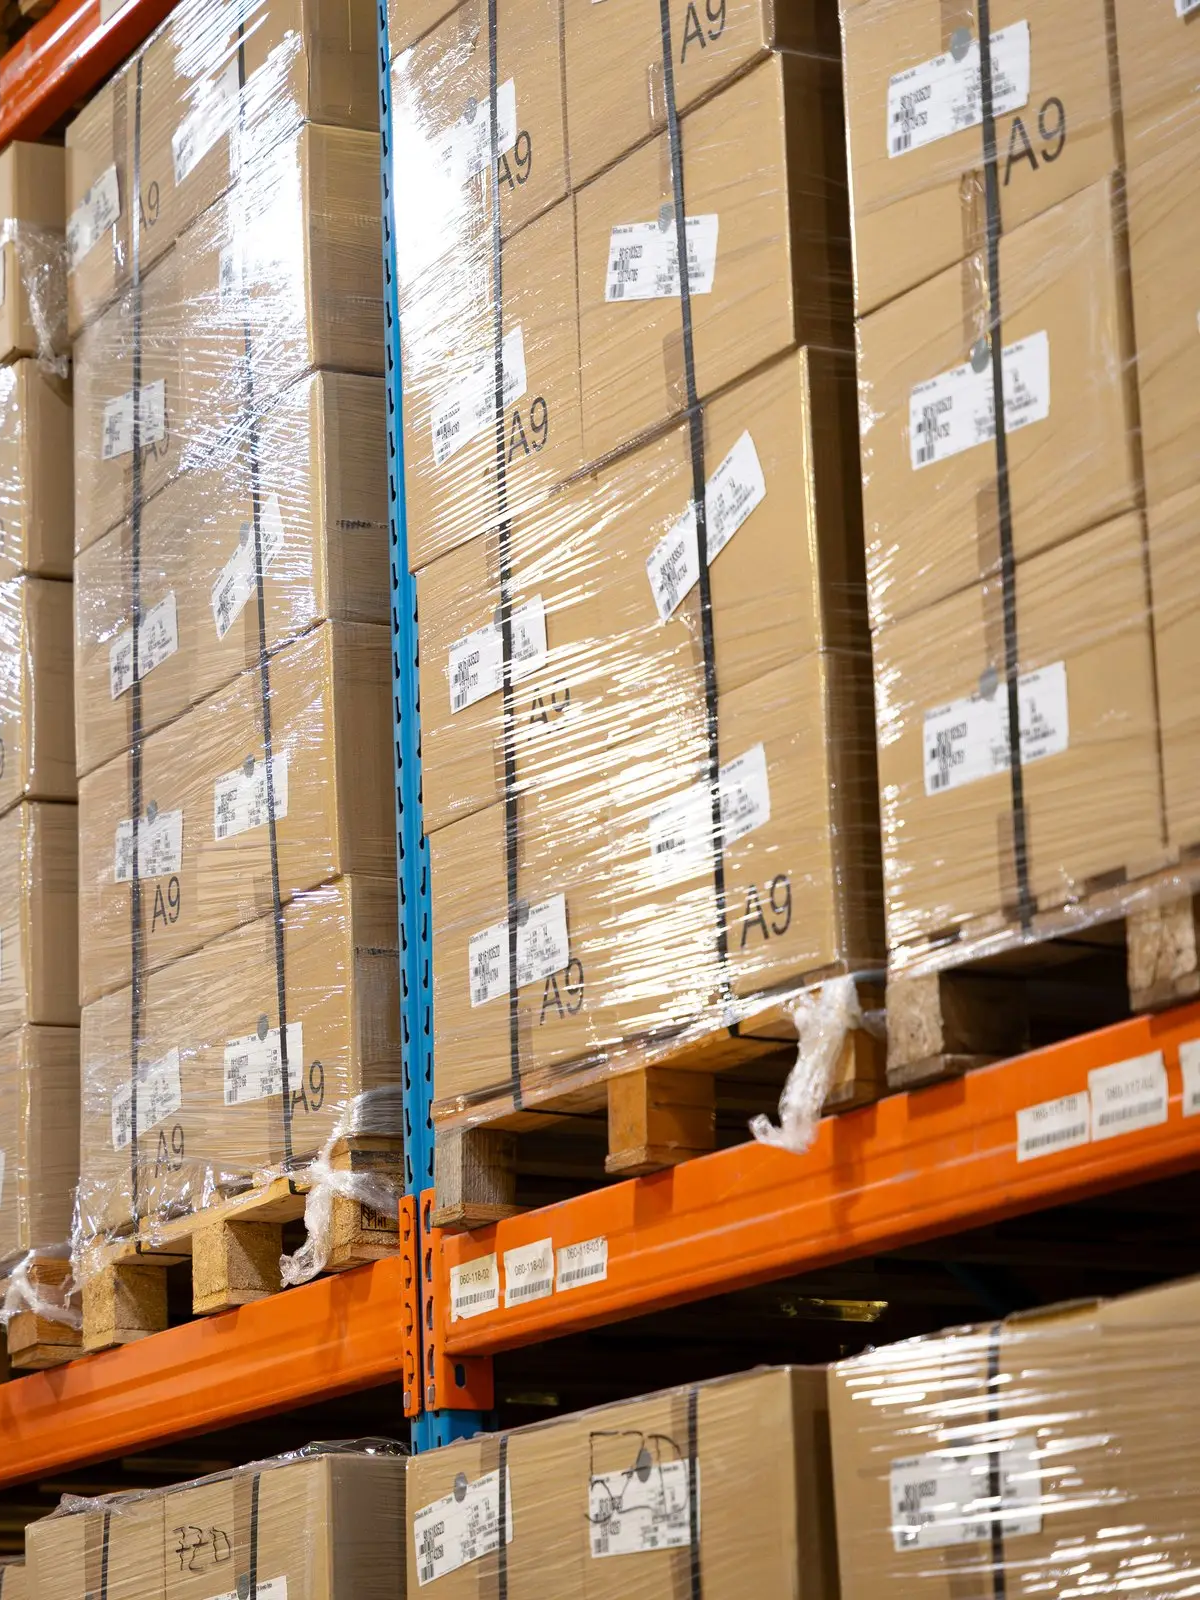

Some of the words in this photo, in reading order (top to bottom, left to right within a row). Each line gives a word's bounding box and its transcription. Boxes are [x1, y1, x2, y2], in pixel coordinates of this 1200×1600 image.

[681, 0, 725, 64] A9
[1004, 97, 1066, 186] A9
[508, 397, 548, 463] A9
[152, 876, 181, 933] A9
[741, 873, 792, 948] A9
[540, 957, 584, 1026] A9
[291, 1059, 325, 1121] A9
[155, 1123, 184, 1178] A9
[459, 1267, 490, 1286] 060-118-02
[515, 1256, 546, 1276] 060-118-01
